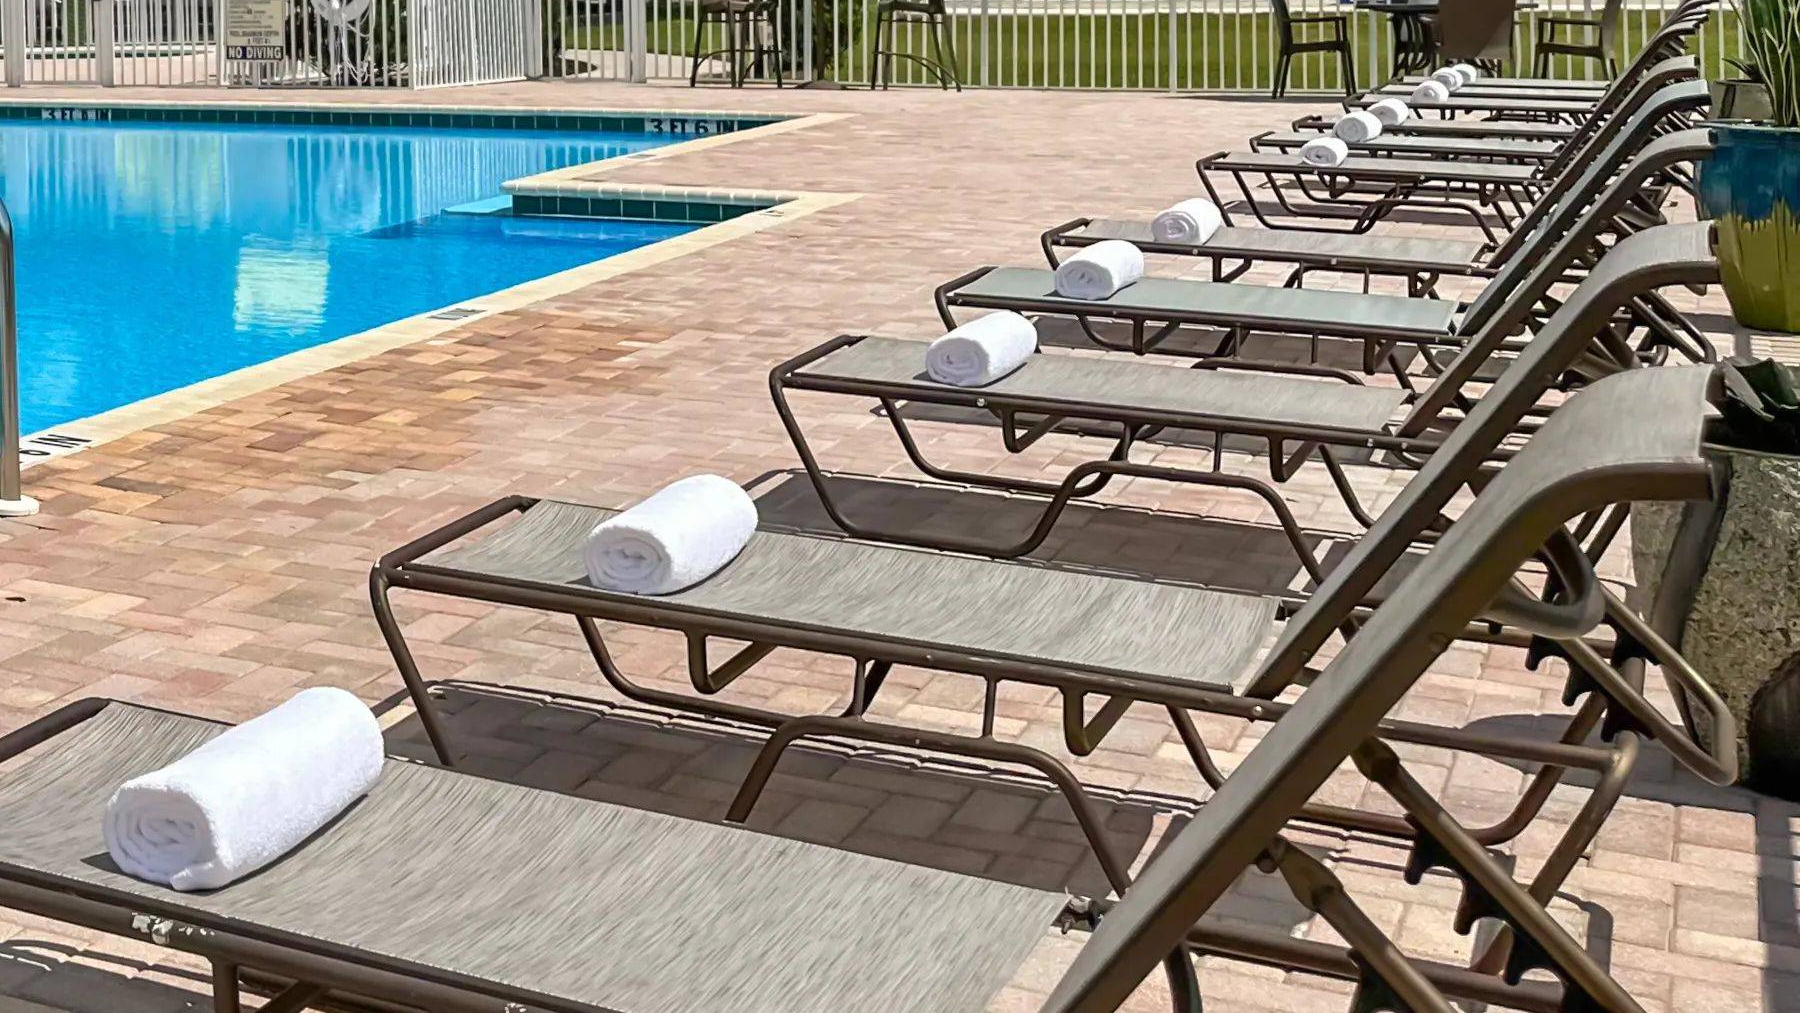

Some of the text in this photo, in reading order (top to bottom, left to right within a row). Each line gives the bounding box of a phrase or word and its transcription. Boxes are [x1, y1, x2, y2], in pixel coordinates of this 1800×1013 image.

[228, 46, 282, 59] NO DIVING
[649, 118, 736, 134] 3 FT 6 IN
